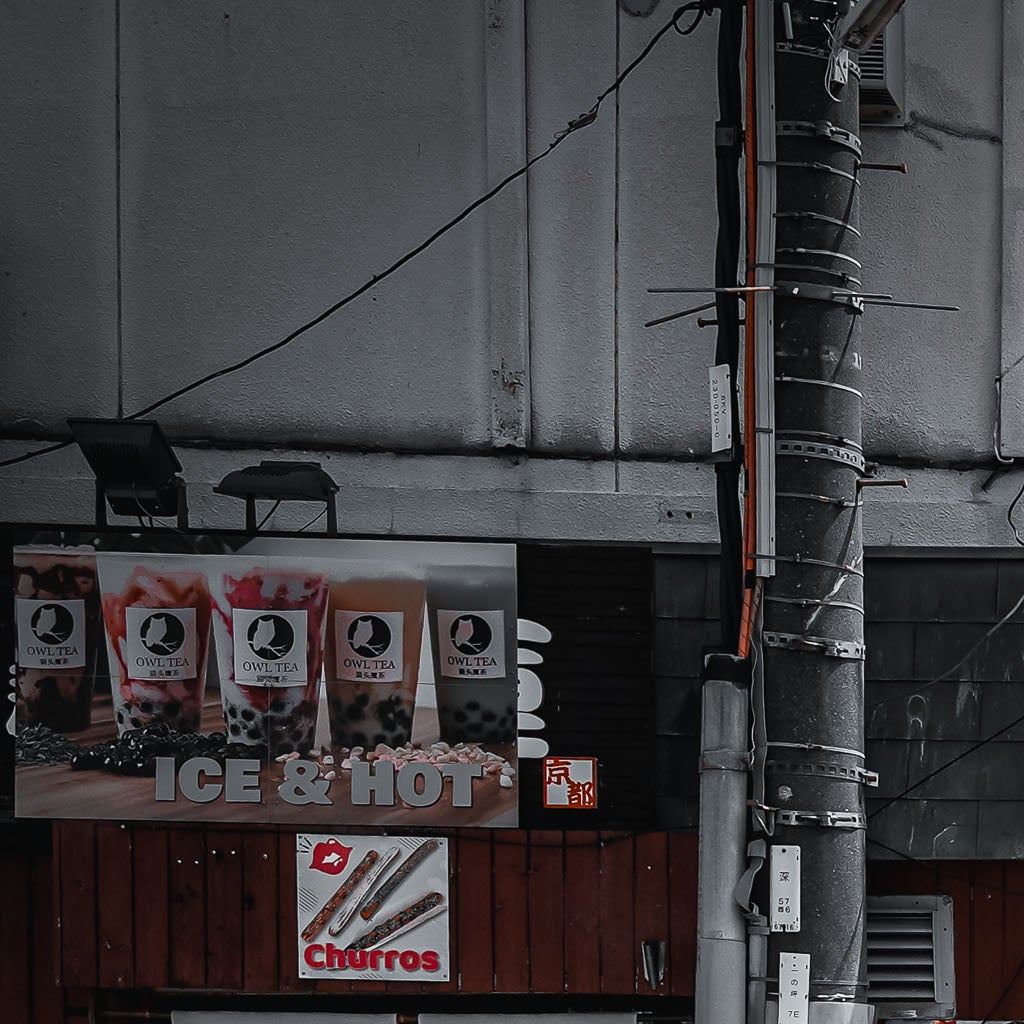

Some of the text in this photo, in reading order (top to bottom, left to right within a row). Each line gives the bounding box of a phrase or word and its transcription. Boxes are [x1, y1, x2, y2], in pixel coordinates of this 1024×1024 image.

[27, 646, 79, 657] OWL TEA
[136, 657, 190, 668] OWL TEA
[343, 658, 396, 671] OWL TEA
[447, 655, 498, 667] OWL TEA
[242, 662, 300, 673] OWL TEA
[155, 756, 483, 808] ICE & HOT
[546, 757, 595, 807] 京都
[778, 897, 790, 905] 57
[303, 942, 440, 972] Churros
